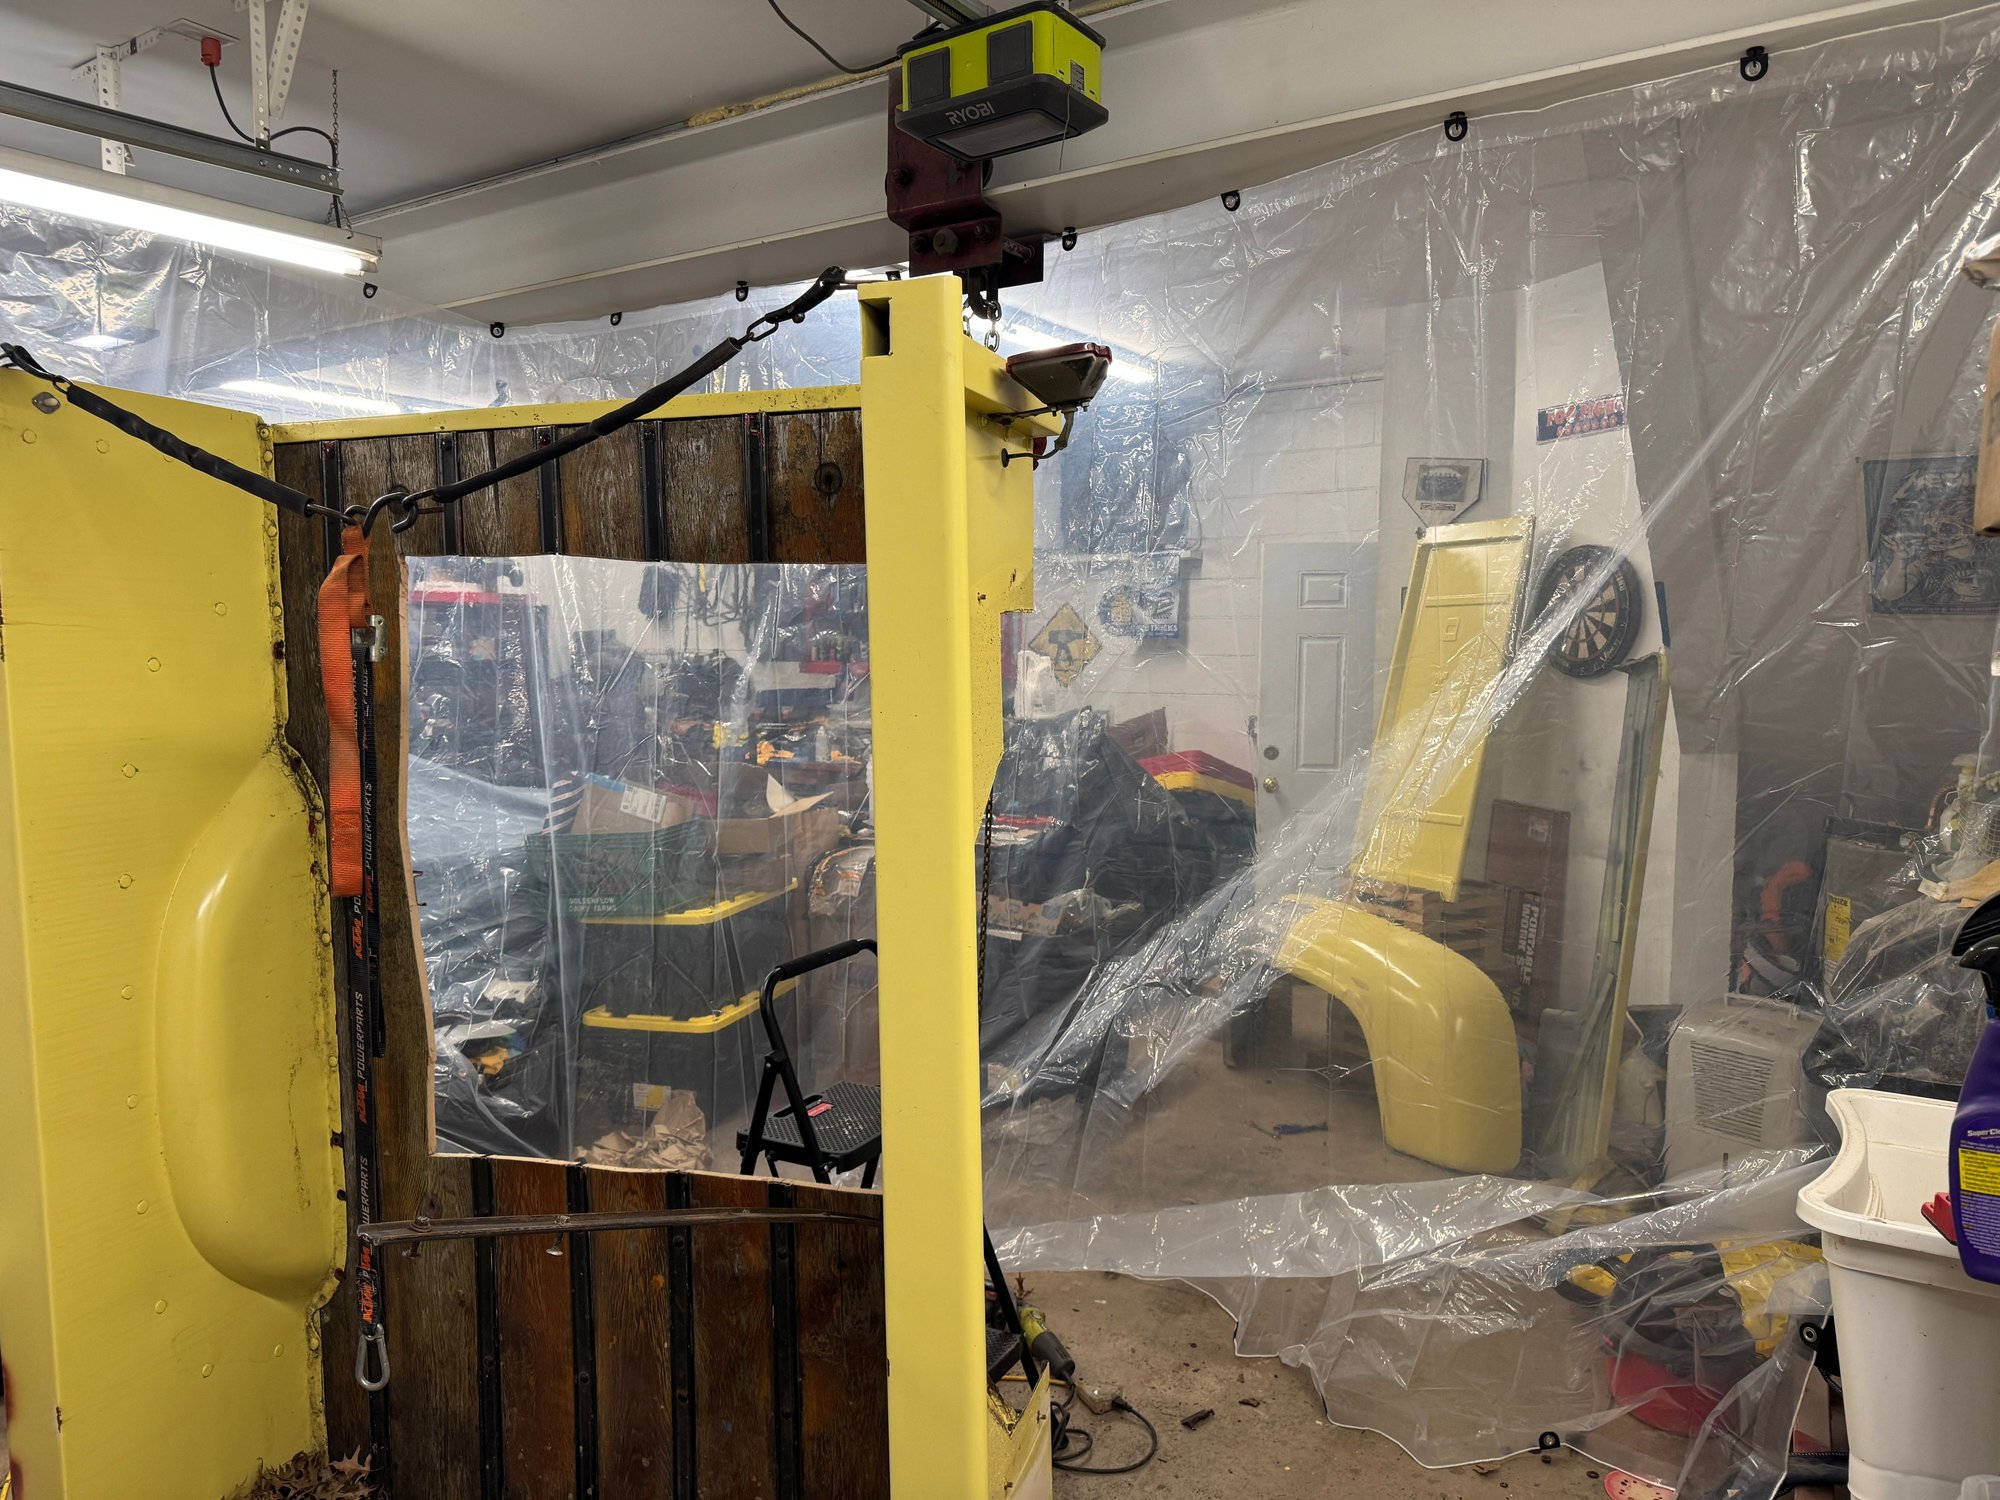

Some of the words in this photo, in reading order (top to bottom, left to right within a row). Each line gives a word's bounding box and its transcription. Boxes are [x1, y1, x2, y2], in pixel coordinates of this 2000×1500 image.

[945, 101, 995, 125] RYOBI
[1518, 903, 1531, 951] WORK
[1524, 905, 1539, 985] PORTABLE
[355, 991, 366, 1080] POWERPARTS
